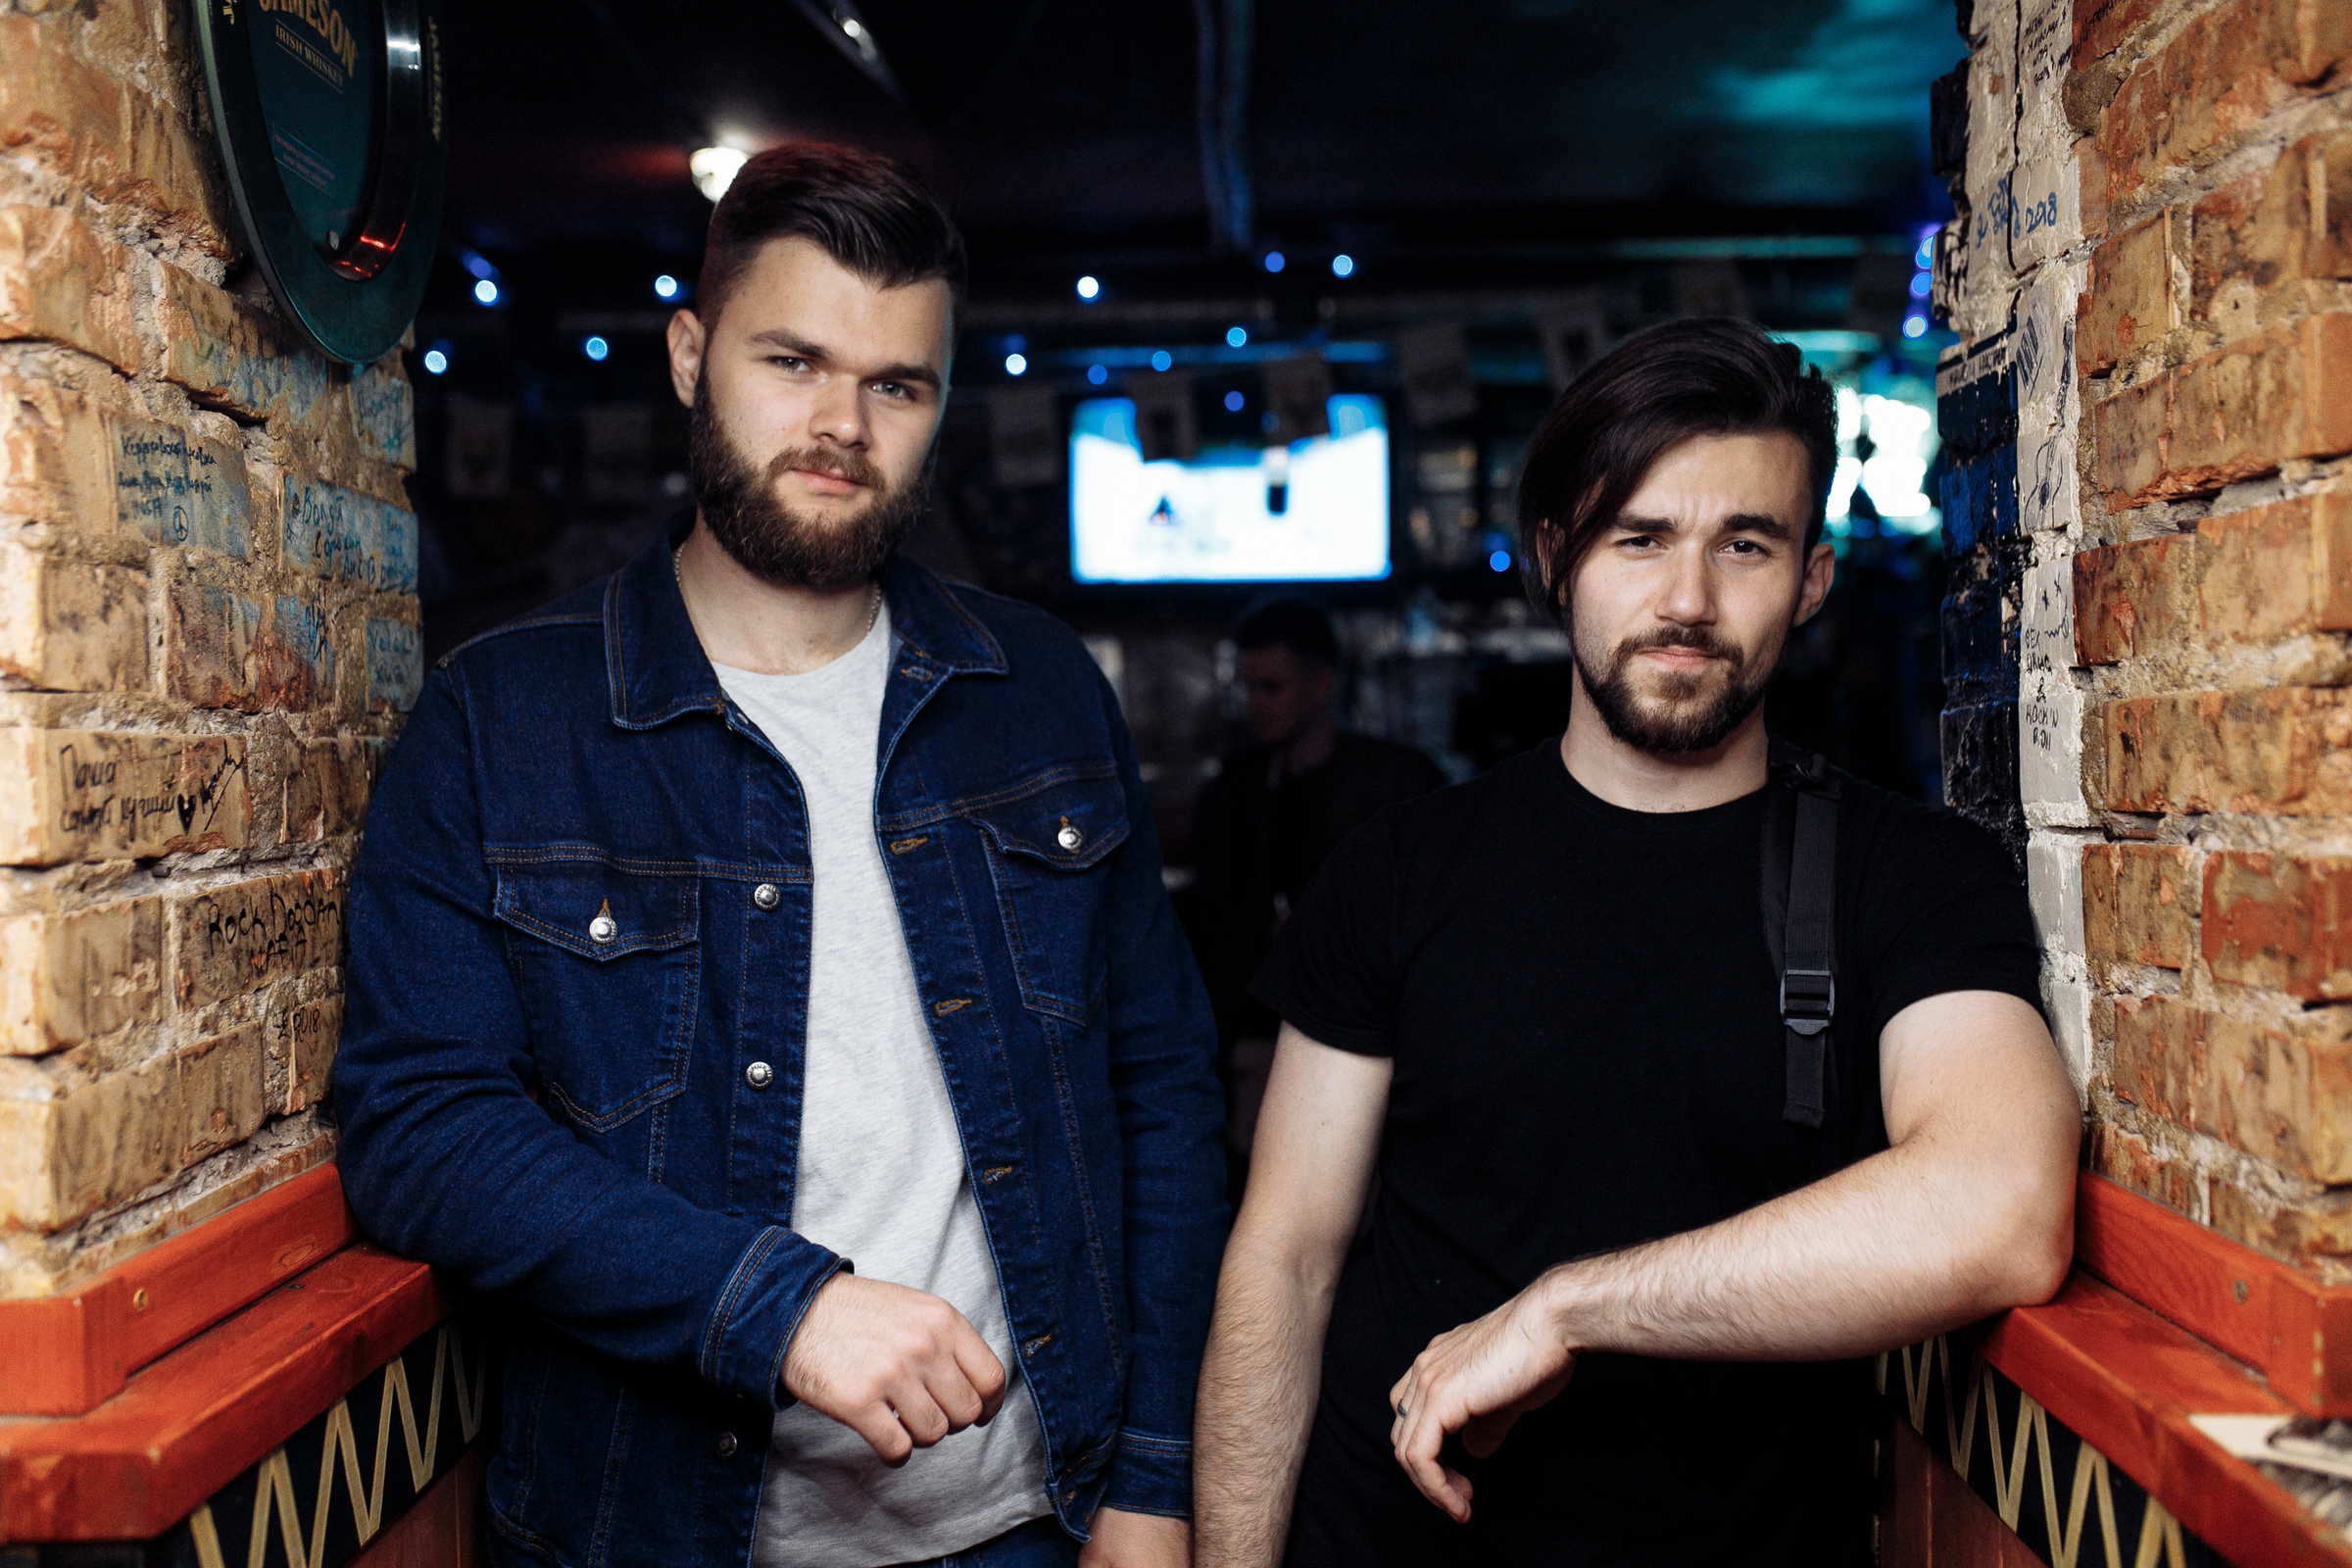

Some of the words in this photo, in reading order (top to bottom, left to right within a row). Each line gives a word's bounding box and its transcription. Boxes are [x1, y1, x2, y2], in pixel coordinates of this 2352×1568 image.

[259, 0, 355, 78] ESON
[275, 24, 303, 56] IRISH
[304, 45, 344, 87] WHISKEY
